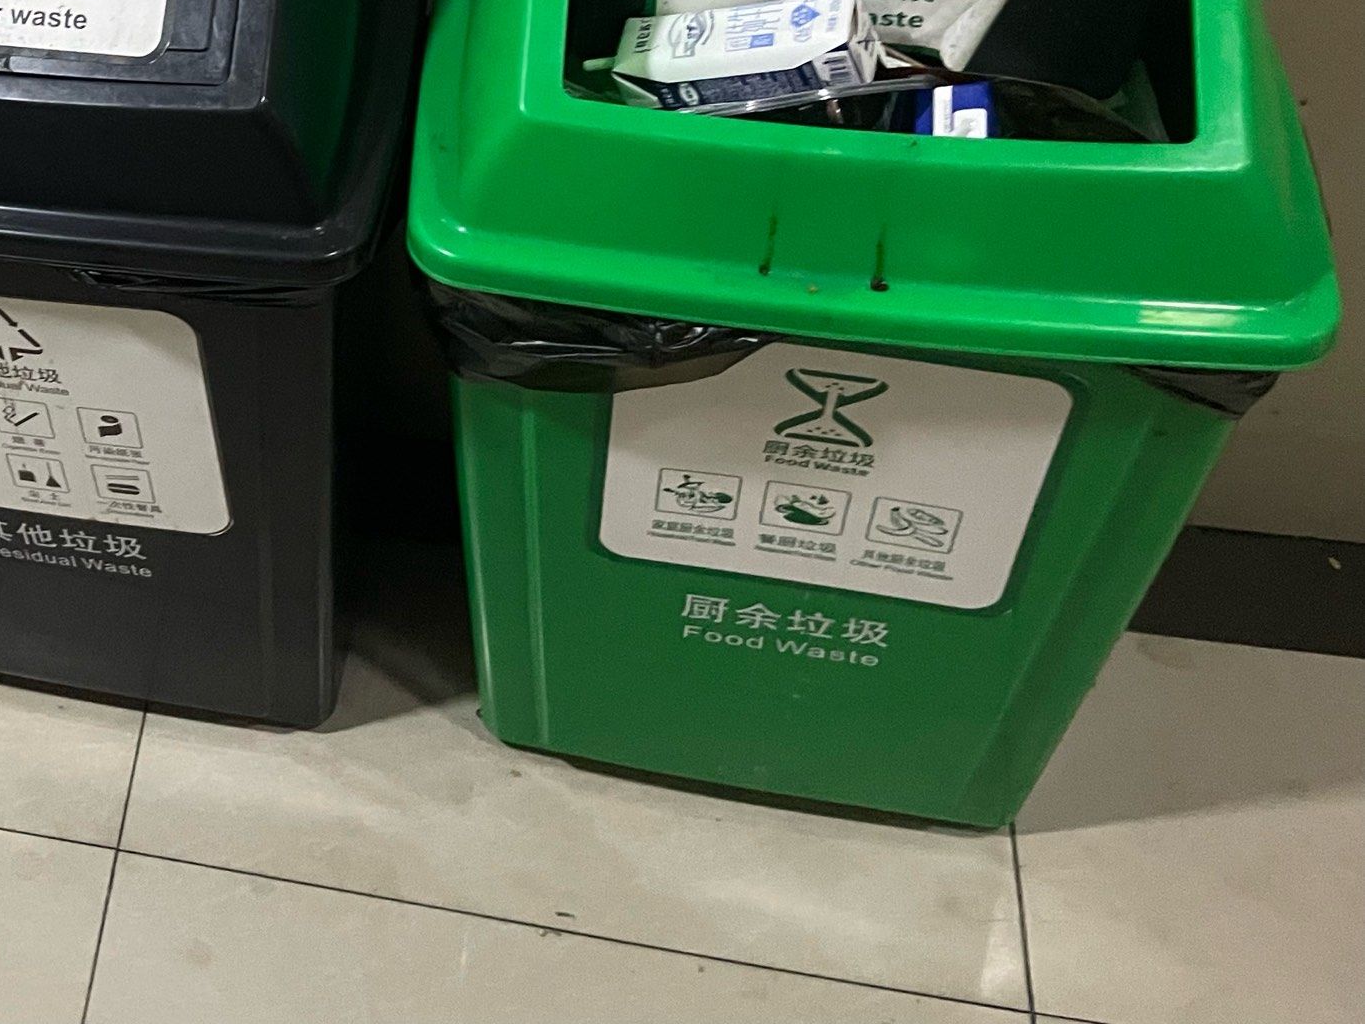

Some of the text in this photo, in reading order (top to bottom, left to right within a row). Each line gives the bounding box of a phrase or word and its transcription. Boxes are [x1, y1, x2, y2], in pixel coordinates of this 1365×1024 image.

[11, 8, 88, 30] waste
[25, 383, 70, 396] Waste
[762, 440, 875, 468] 厨余垃圾
[764, 455, 870, 477] Food Waste
[81, 557, 153, 577] Waste
[681, 593, 889, 648] 厨余垃圾
[683, 624, 880, 667] Food Waste
